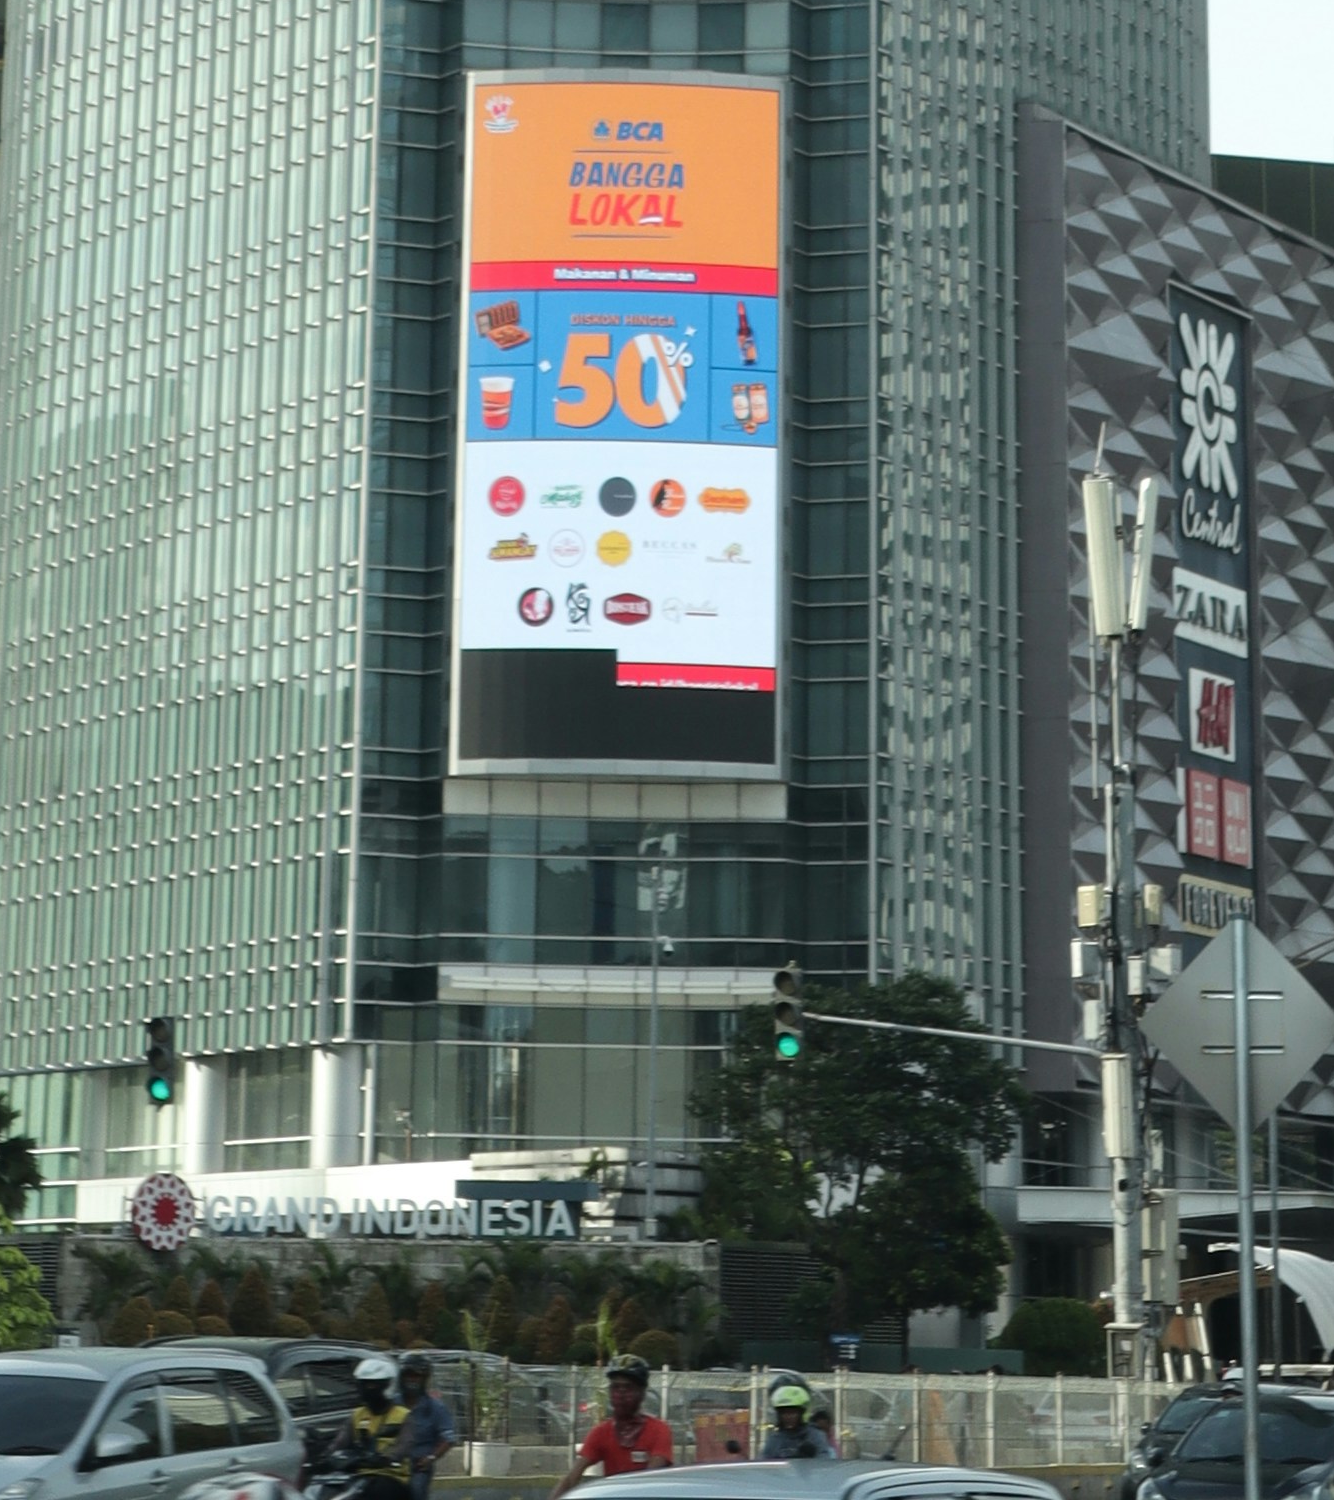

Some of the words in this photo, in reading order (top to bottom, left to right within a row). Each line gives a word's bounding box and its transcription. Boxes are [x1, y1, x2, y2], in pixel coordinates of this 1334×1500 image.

[616, 121, 664, 141] BCA
[569, 161, 685, 189] BANGGA
[569, 193, 684, 228] LOKAL
[570, 313, 621, 327] DISKON
[624, 314, 677, 328] HINGGA
[1181, 487, 1243, 555] Central
[1175, 584, 1248, 642] ZARA
[207, 1194, 342, 1235] GRAND
[350, 1197, 577, 1238] INDONESIA
